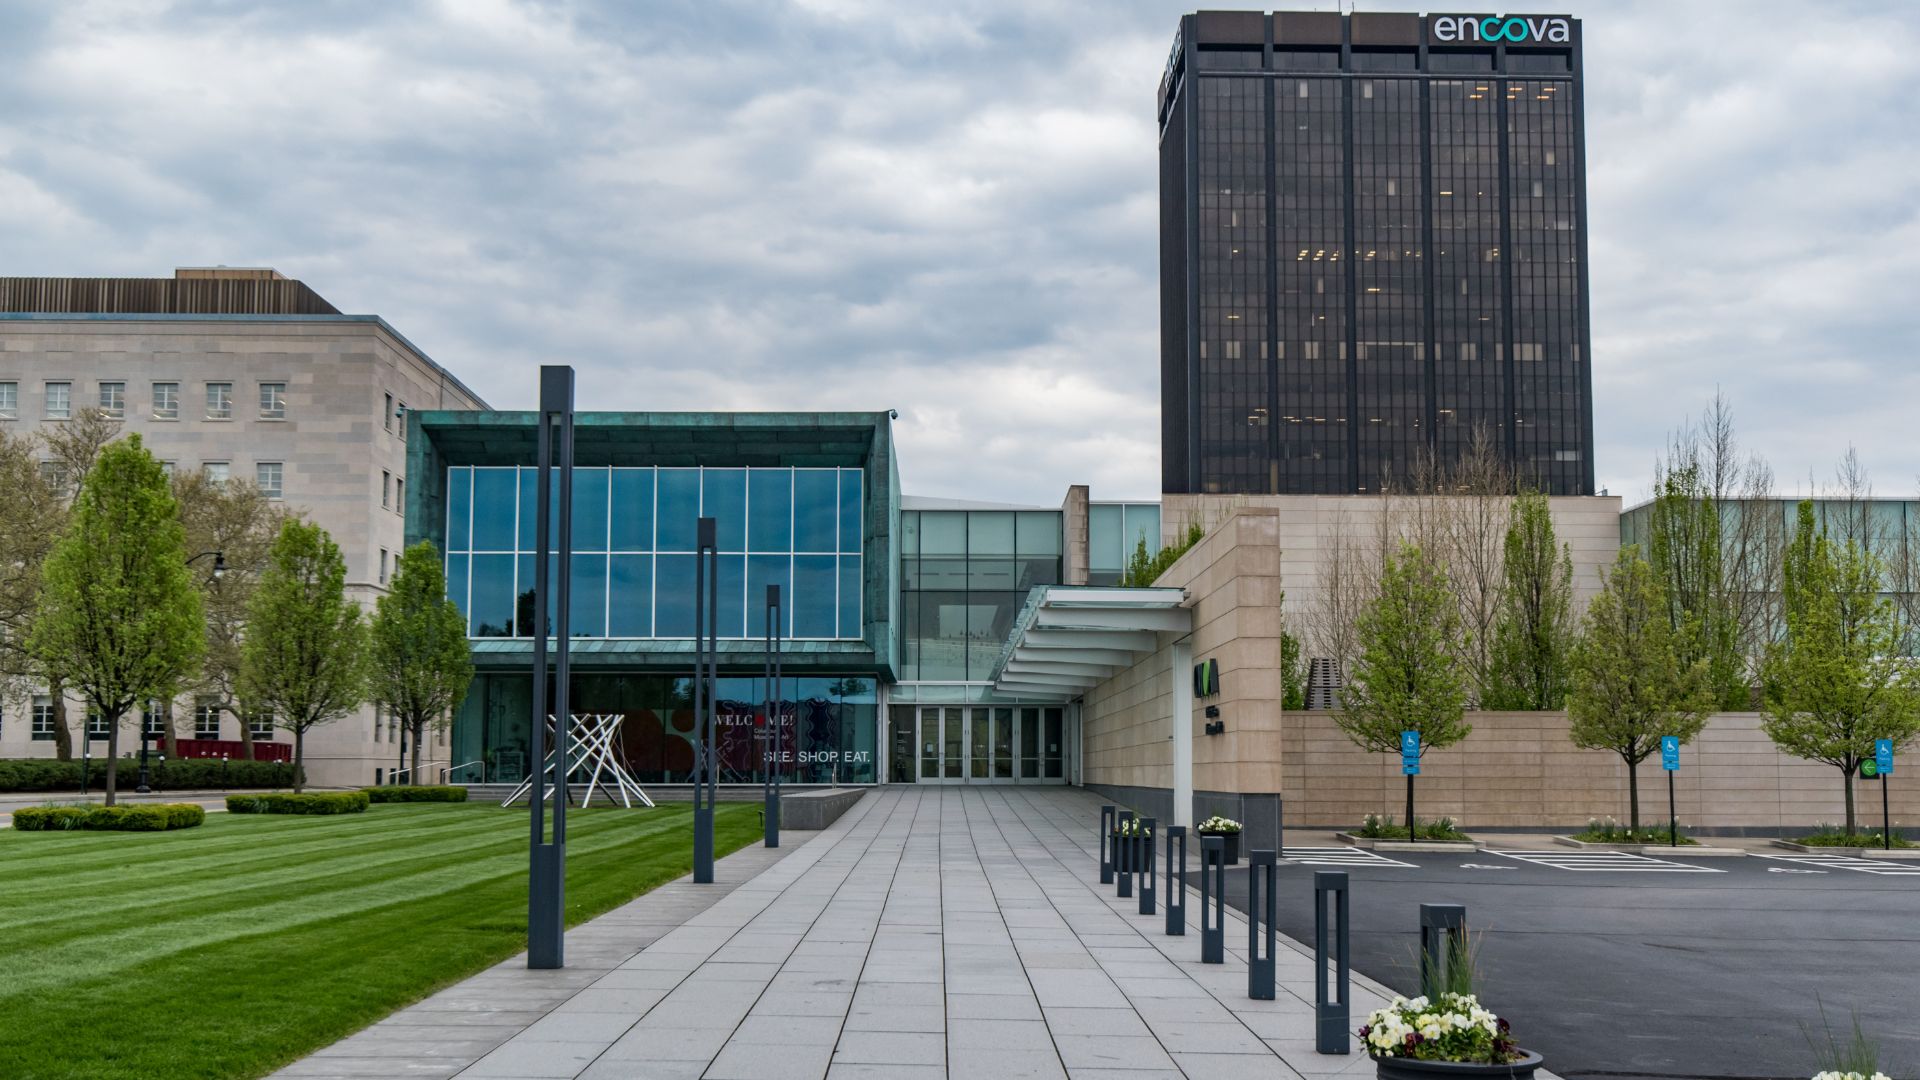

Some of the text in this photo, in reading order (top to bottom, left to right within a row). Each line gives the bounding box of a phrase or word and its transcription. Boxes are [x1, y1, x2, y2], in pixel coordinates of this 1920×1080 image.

[1434, 16, 1570, 42] encova
[798, 751, 840, 763] SHOP.
[844, 751, 870, 763] EAT.
